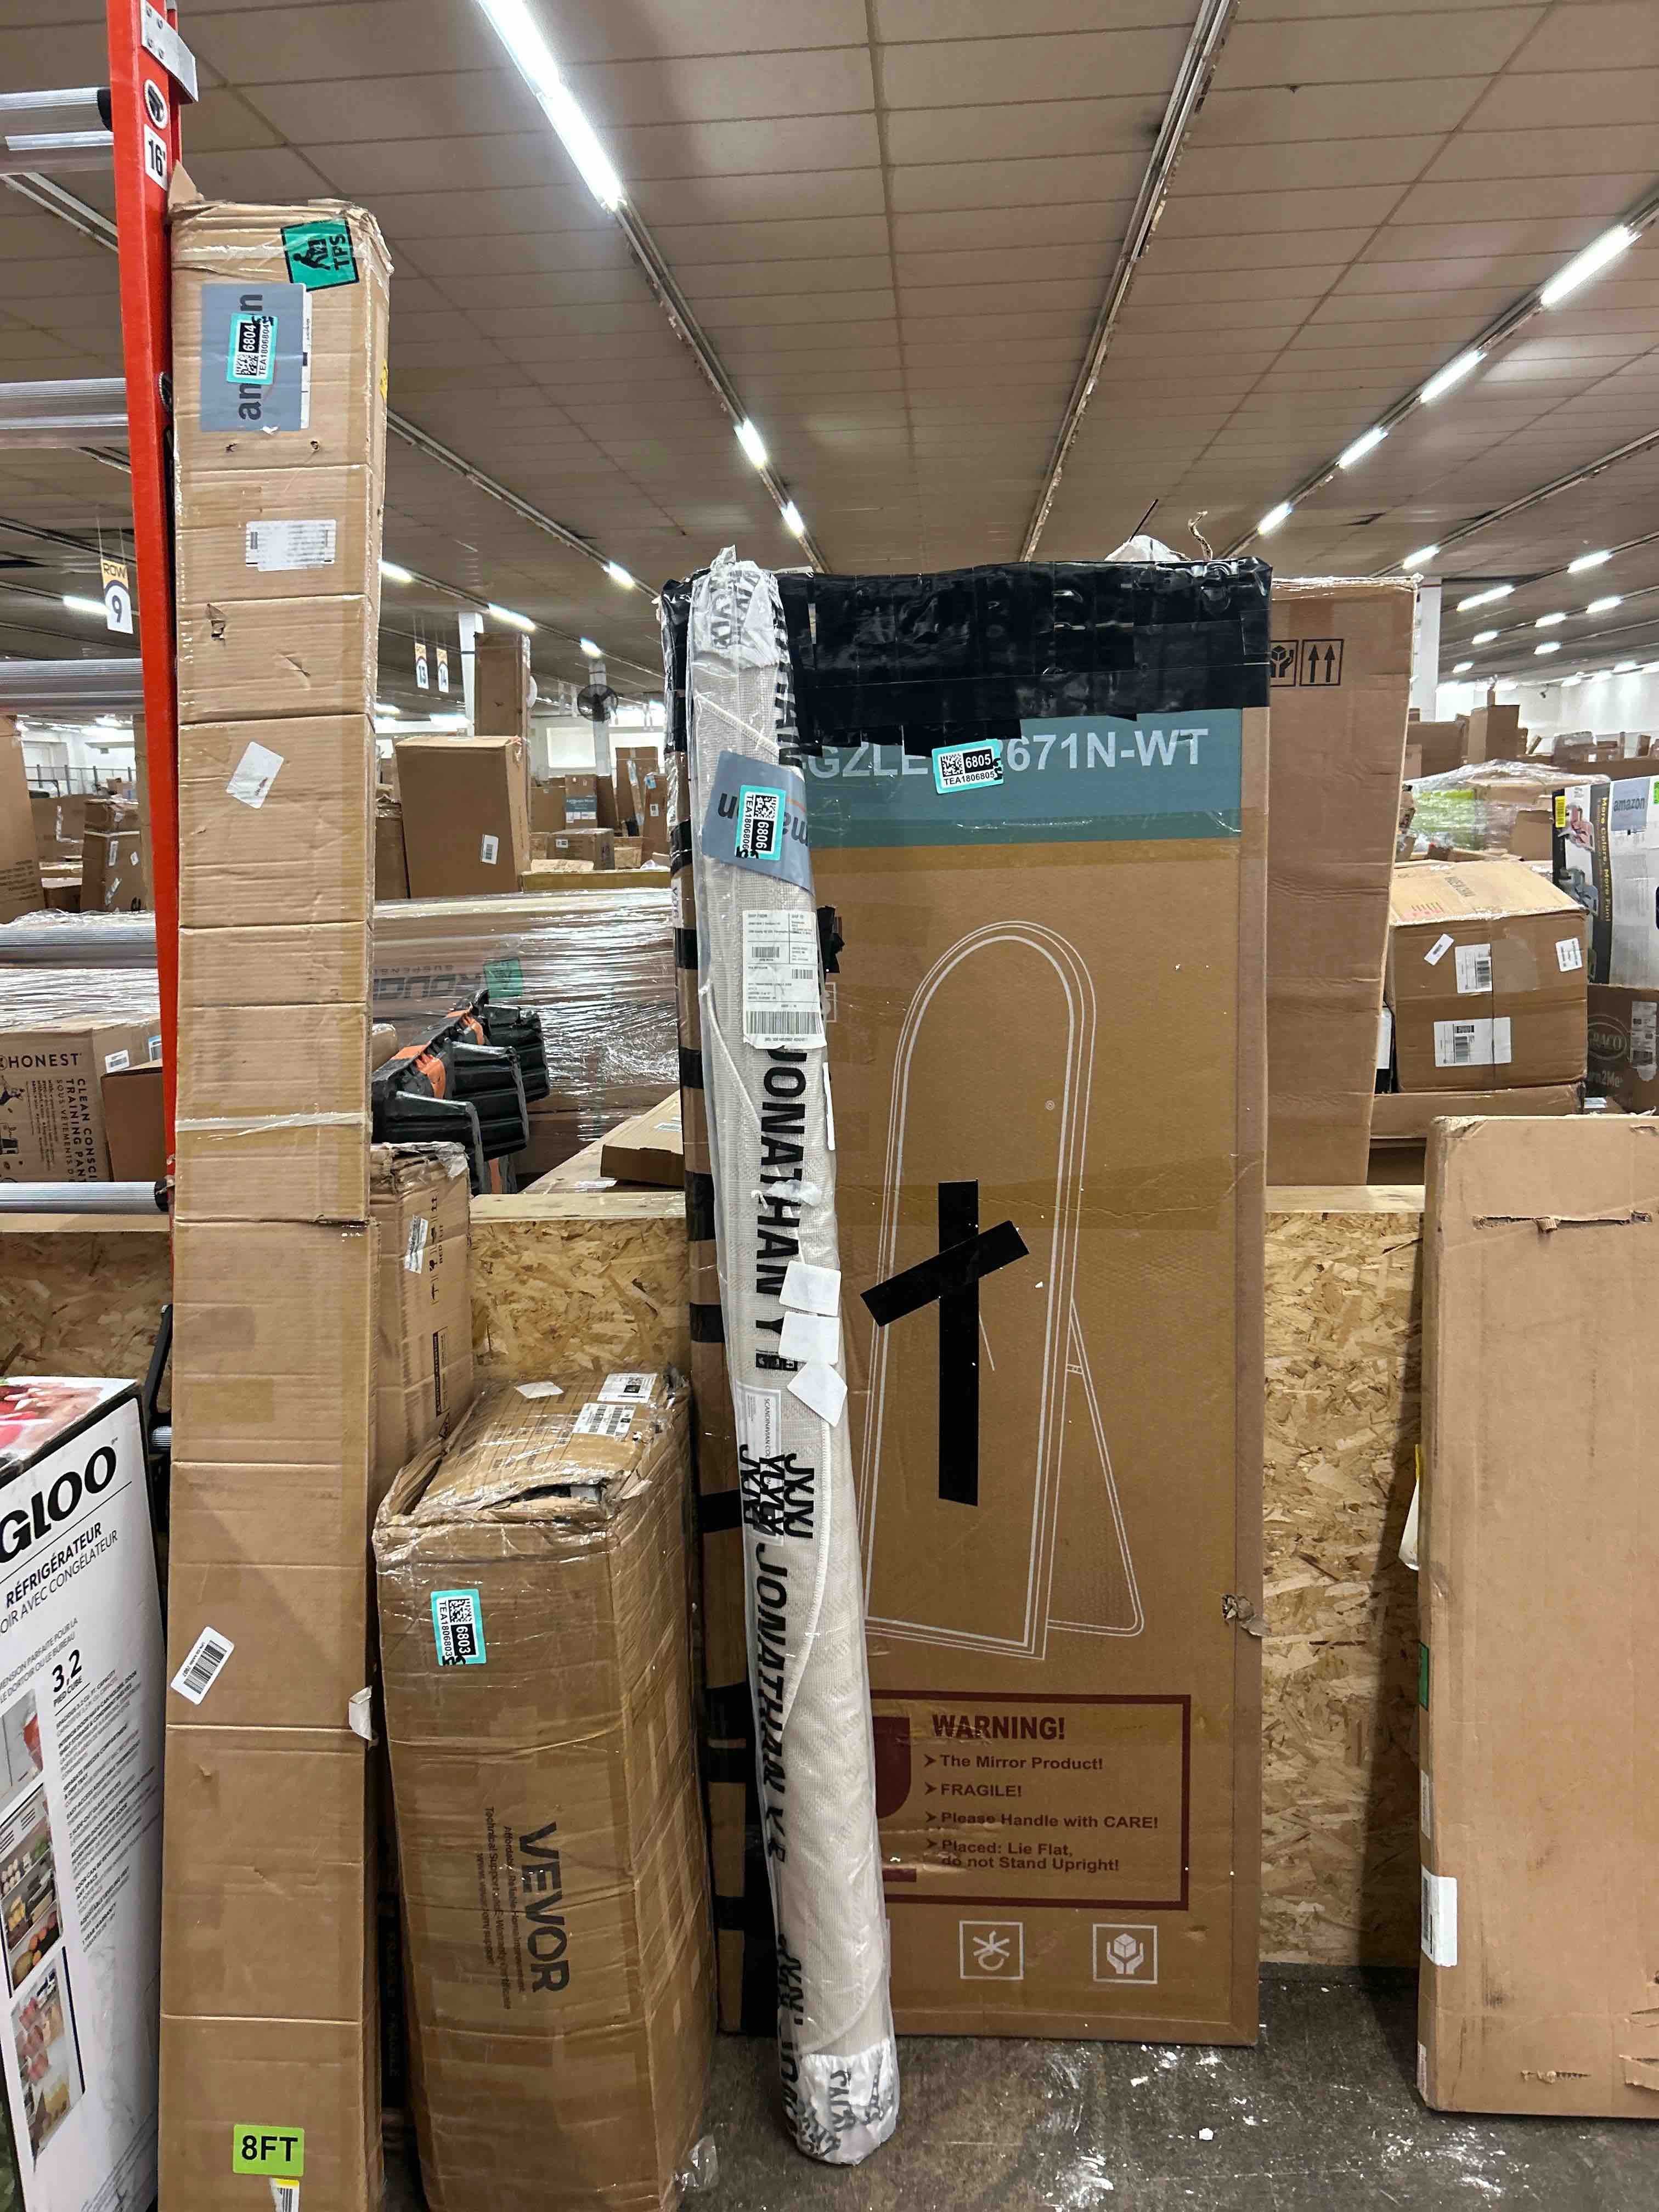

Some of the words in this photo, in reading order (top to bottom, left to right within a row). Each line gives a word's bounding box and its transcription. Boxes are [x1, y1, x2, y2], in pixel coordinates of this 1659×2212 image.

[334, 233, 348, 272] TPS
[242, 324, 257, 352] 6804
[258, 324, 269, 376] TEA1806804
[103, 560, 127, 578] ROW
[111, 595, 123, 624] 9
[418, 665, 427, 685] 13
[803, 741, 929, 779] GZLE
[996, 727, 1209, 772] 671N-WT
[965, 753, 992, 769] 6805
[943, 771, 995, 786] TEA1806805
[1613, 797, 1645, 811] amazon
[742, 794, 754, 850] TEA1806806
[755, 821, 770, 849] 6806
[8, 1053, 78, 1069] HONEST
[66, 1078, 82, 1145] TRAINING
[77, 1078, 91, 1121] CLEAN
[0, 1446, 117, 1563] GLOO
[6, 1522, 102, 1609] RÉFRIGÉRATEUR
[20, 1586, 48, 1619] AVEC
[49, 1530, 119, 1594] CONGÉLATEUR
[54, 1624, 71, 1643] POUR
[71, 1617, 78, 1629] LA
[439, 1600, 453, 1657] TEA1806803
[456, 1626, 471, 1654] 6803
[7, 1667, 35, 1697] DORTOIR
[35, 1659, 45, 1672] OU
[53, 1631, 75, 1656] BUREAU
[52, 1649, 82, 1693] 3,2
[53, 1690, 67, 1707] PIED
[67, 1675, 83, 1694] CUBE
[932, 1714, 1065, 1740] WARNING!
[939, 1754, 972, 1769] The
[975, 1755, 1027, 1770] Mirror
[1031, 1756, 1103, 1771] Product!
[940, 1783, 1023, 1798] FRAGILE!
[484, 1806, 498, 1850] Technical
[941, 1812, 995, 1826] Please
[1000, 1813, 1059, 1829] Handle
[1063, 1814, 1098, 1829] with
[1103, 1815, 1159, 1830] CARE!
[941, 1839, 1002, 1854] Placed:
[1006, 1841, 1033, 1856] Lie
[1037, 1842, 1074, 1858] Flat,
[488, 1853, 500, 1891] Support
[941, 1854, 962, 1867] do
[966, 1855, 995, 1870] not
[998, 1855, 1047, 1871] Stand
[1052, 1857, 1119, 1874] Upright!
[518, 1821, 571, 1993] VEVOR
[240, 2135, 300, 2163] 8FT
